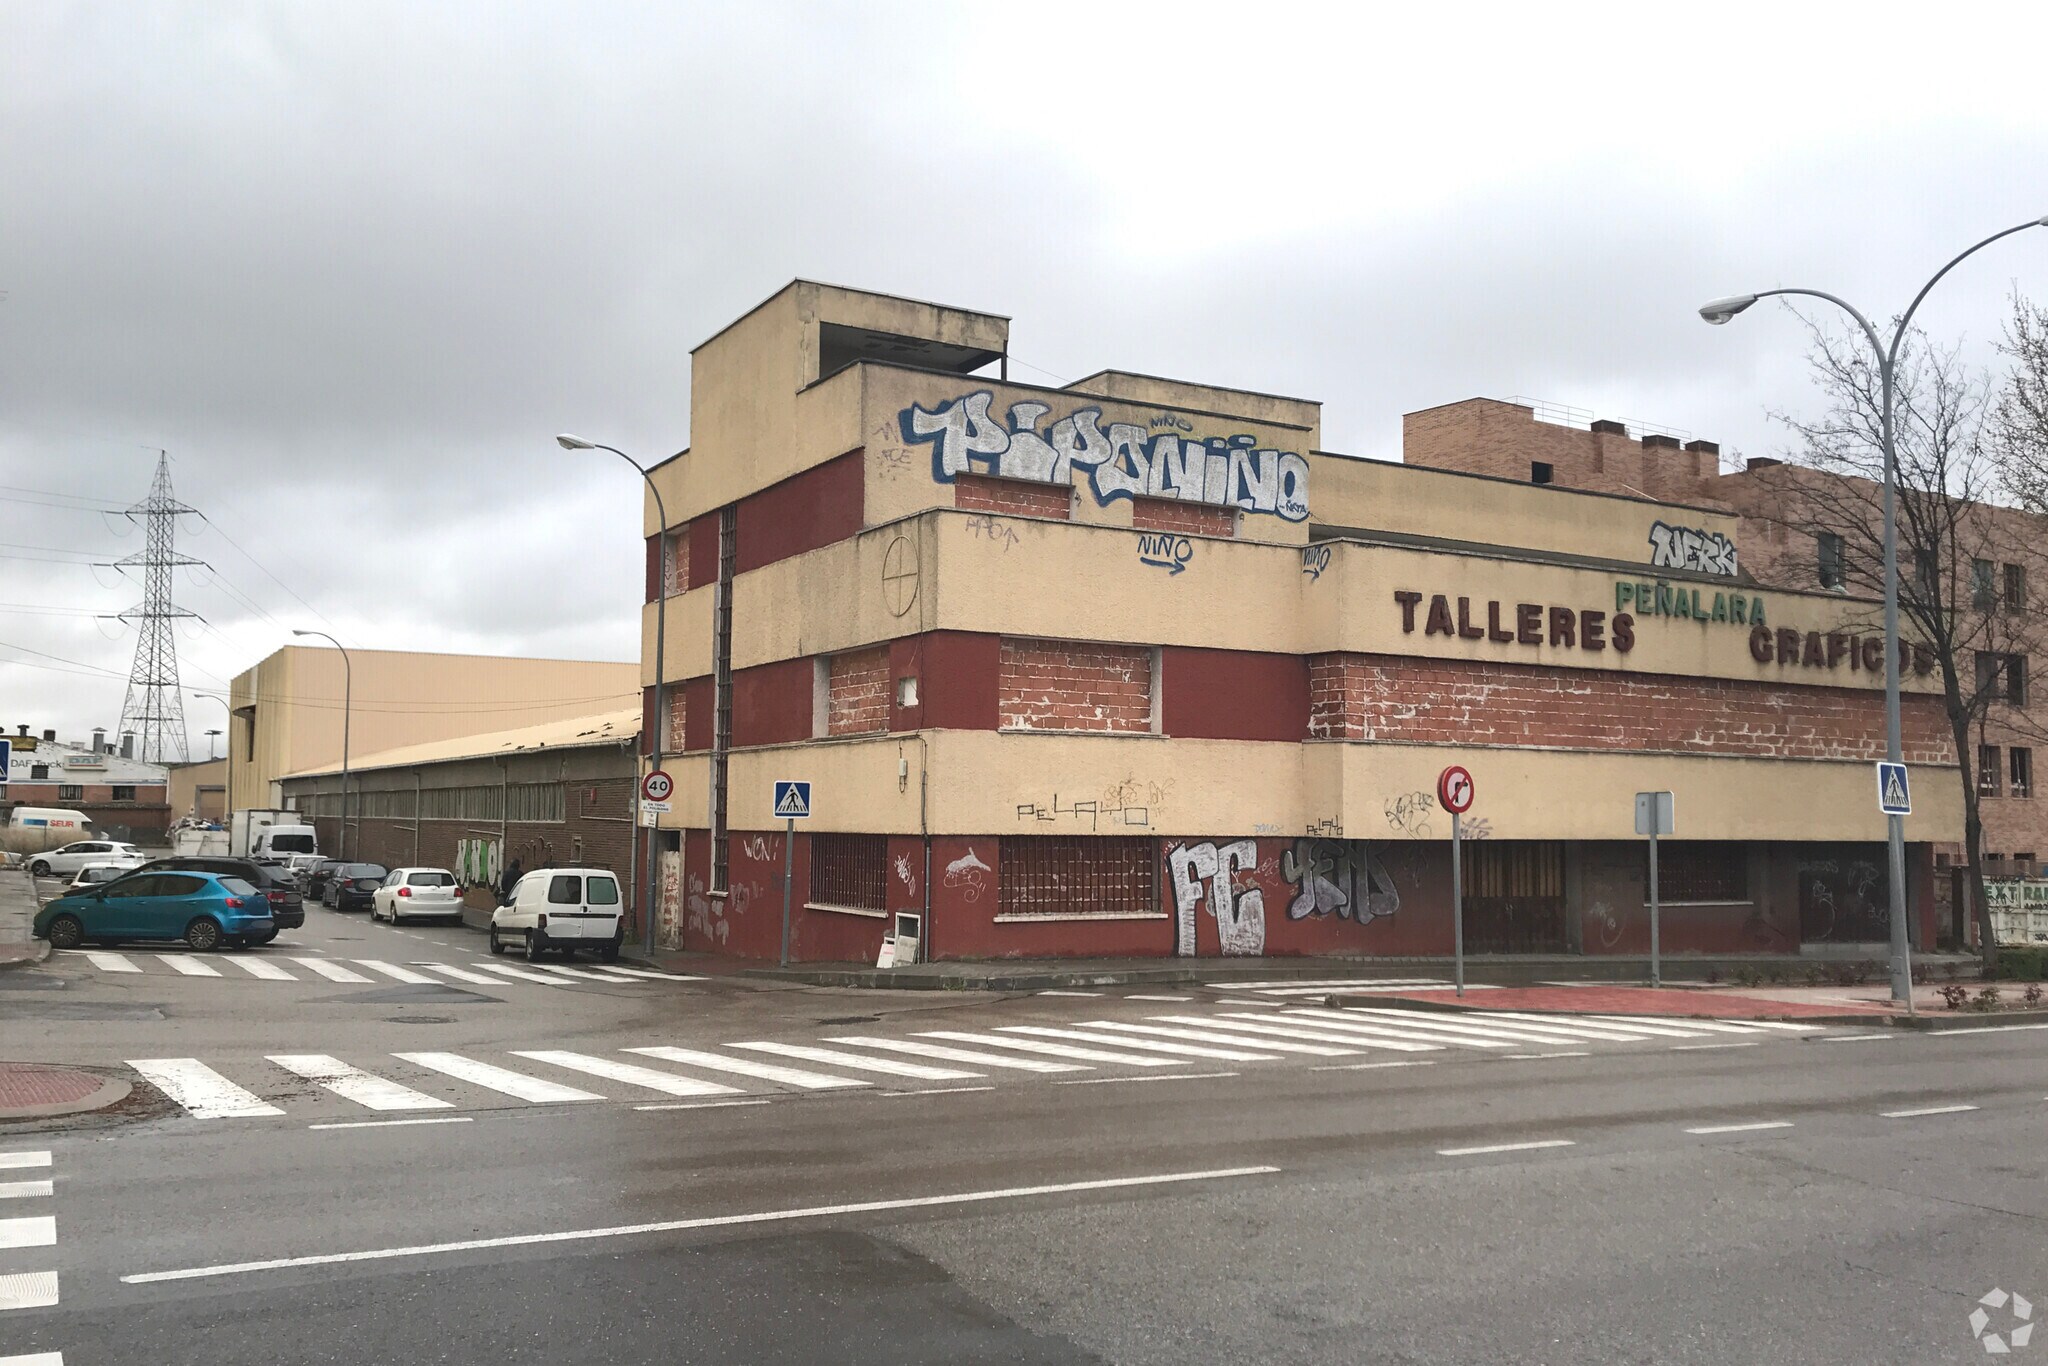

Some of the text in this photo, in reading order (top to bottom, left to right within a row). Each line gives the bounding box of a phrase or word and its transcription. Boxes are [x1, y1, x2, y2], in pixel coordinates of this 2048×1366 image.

[1137, 535, 1193, 562] NIÑO
[1615, 579, 1766, 625] PEÑALARA
[1394, 590, 1635, 652] TALLERES
[10, 759, 31, 767] DAF
[648, 781, 668, 791] 40
[50, 820, 74, 828] SEUR
